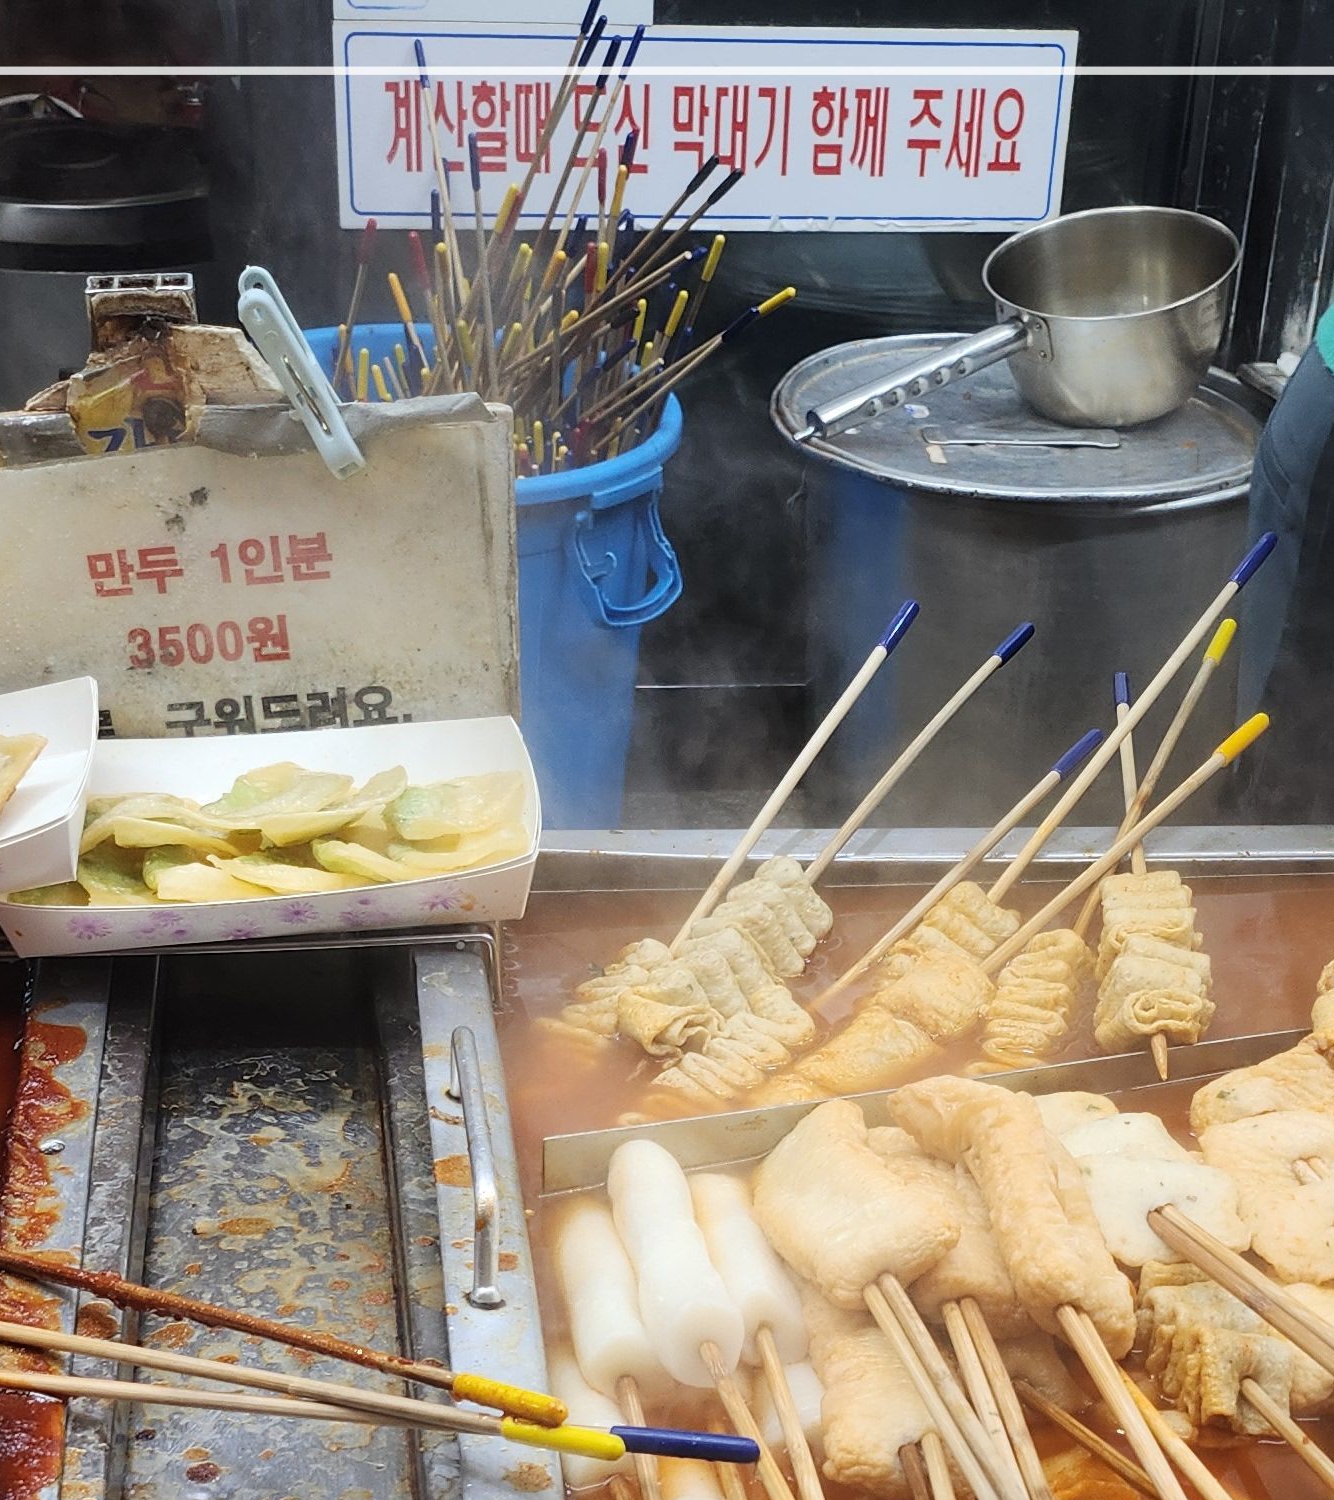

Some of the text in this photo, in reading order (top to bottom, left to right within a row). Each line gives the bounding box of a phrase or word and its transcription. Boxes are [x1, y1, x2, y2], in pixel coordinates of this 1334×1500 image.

[385, 79, 1025, 178] 계산할때 드신 막대기 함께 주세요
[87, 532, 333, 597] 만두 1인분
[127, 614, 291, 669] 3500원
